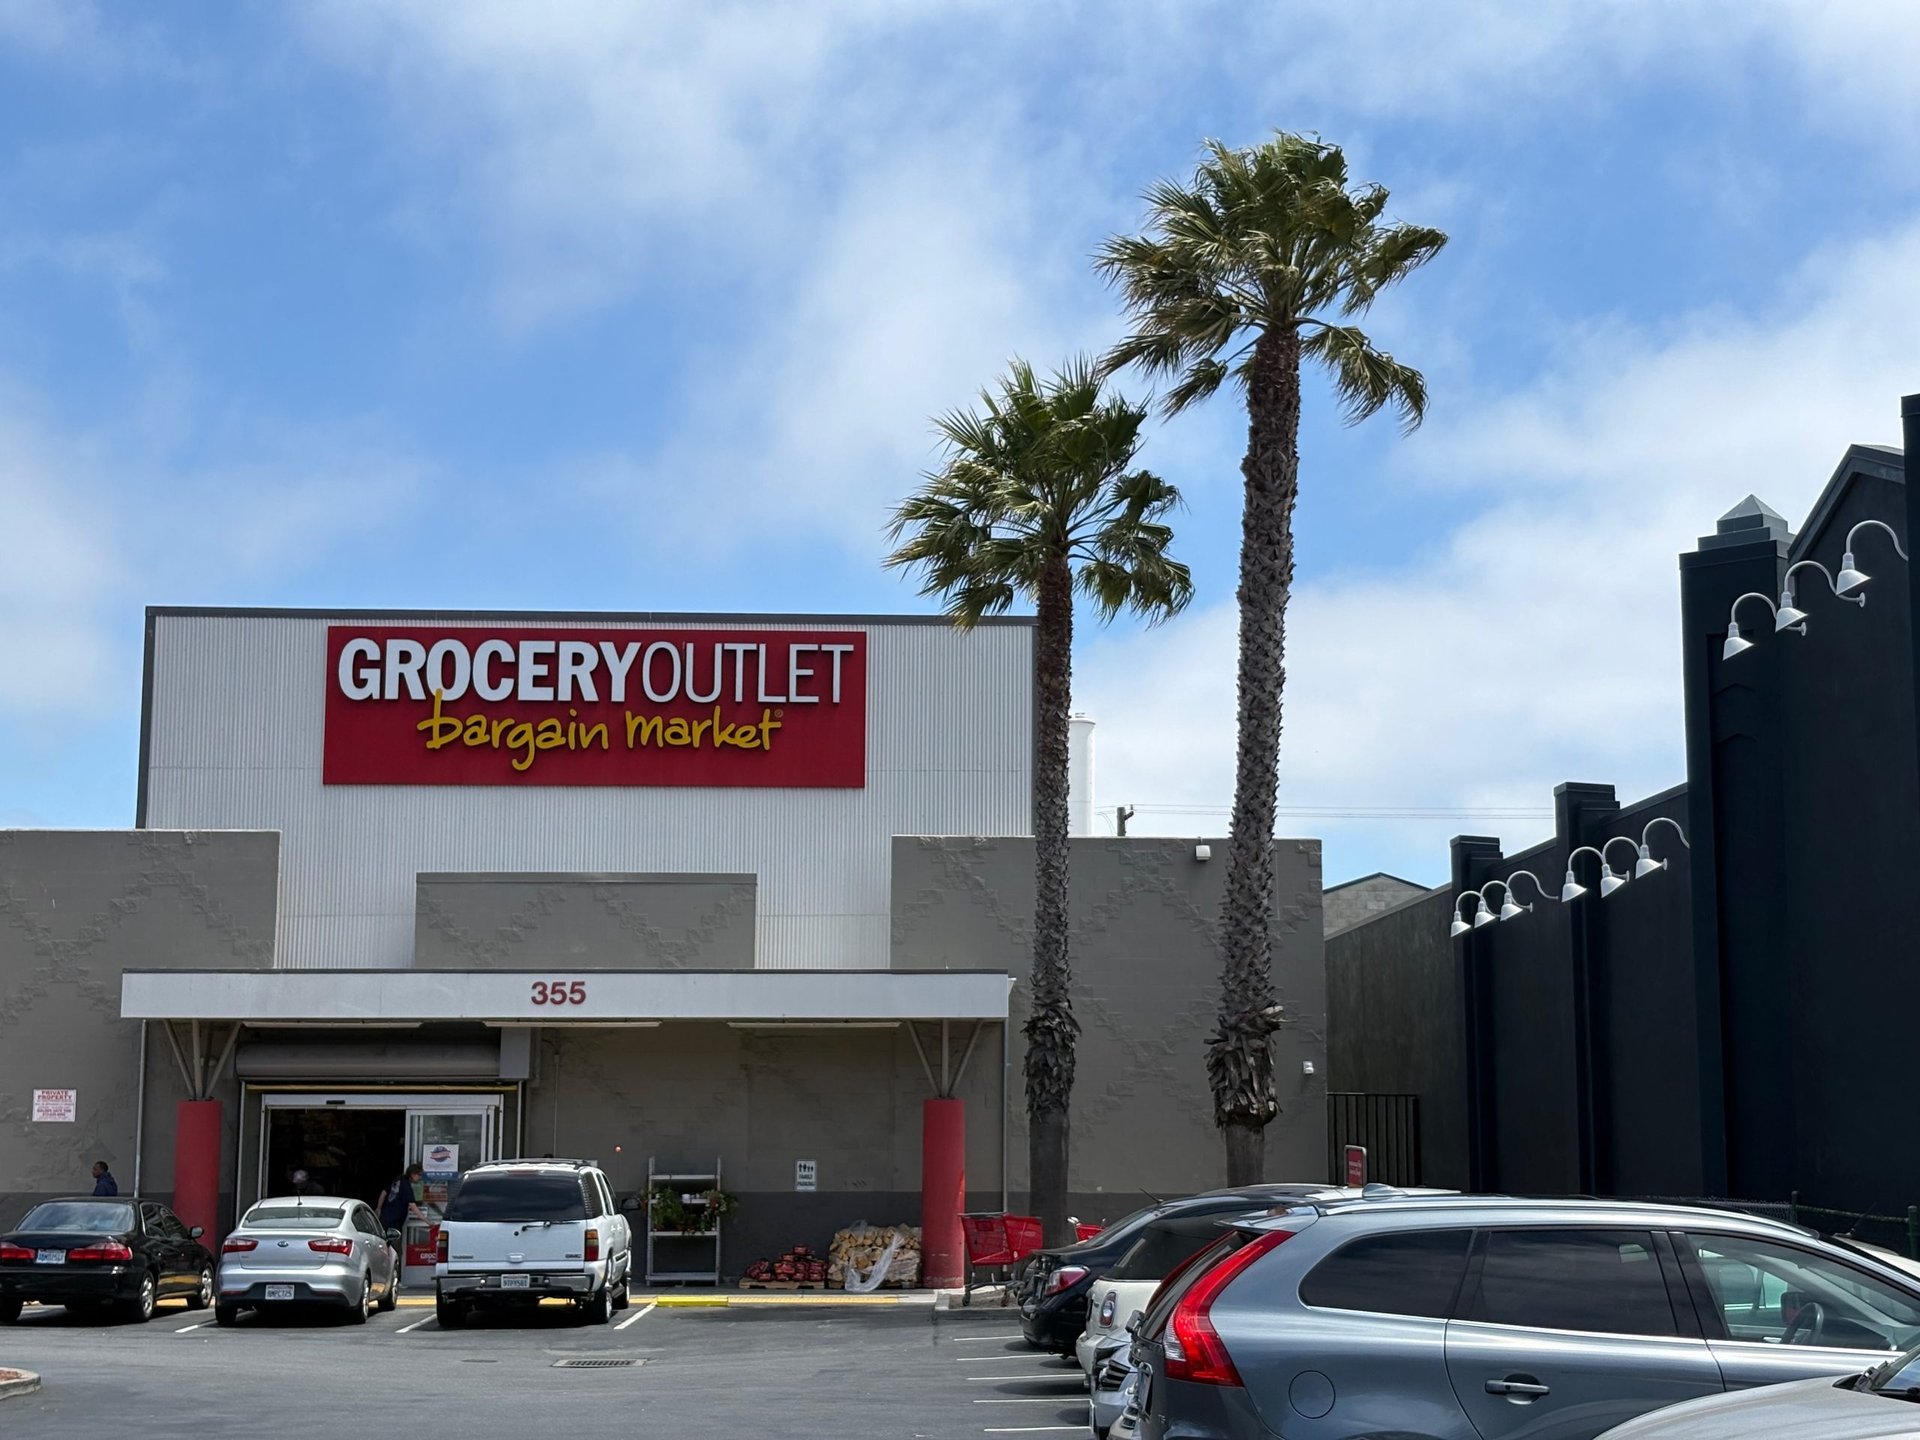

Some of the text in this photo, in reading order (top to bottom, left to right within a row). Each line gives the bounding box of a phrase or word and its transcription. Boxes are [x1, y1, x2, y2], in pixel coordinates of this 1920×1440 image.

[416, 688, 782, 771] bargain market
[531, 981, 586, 1005] 355
